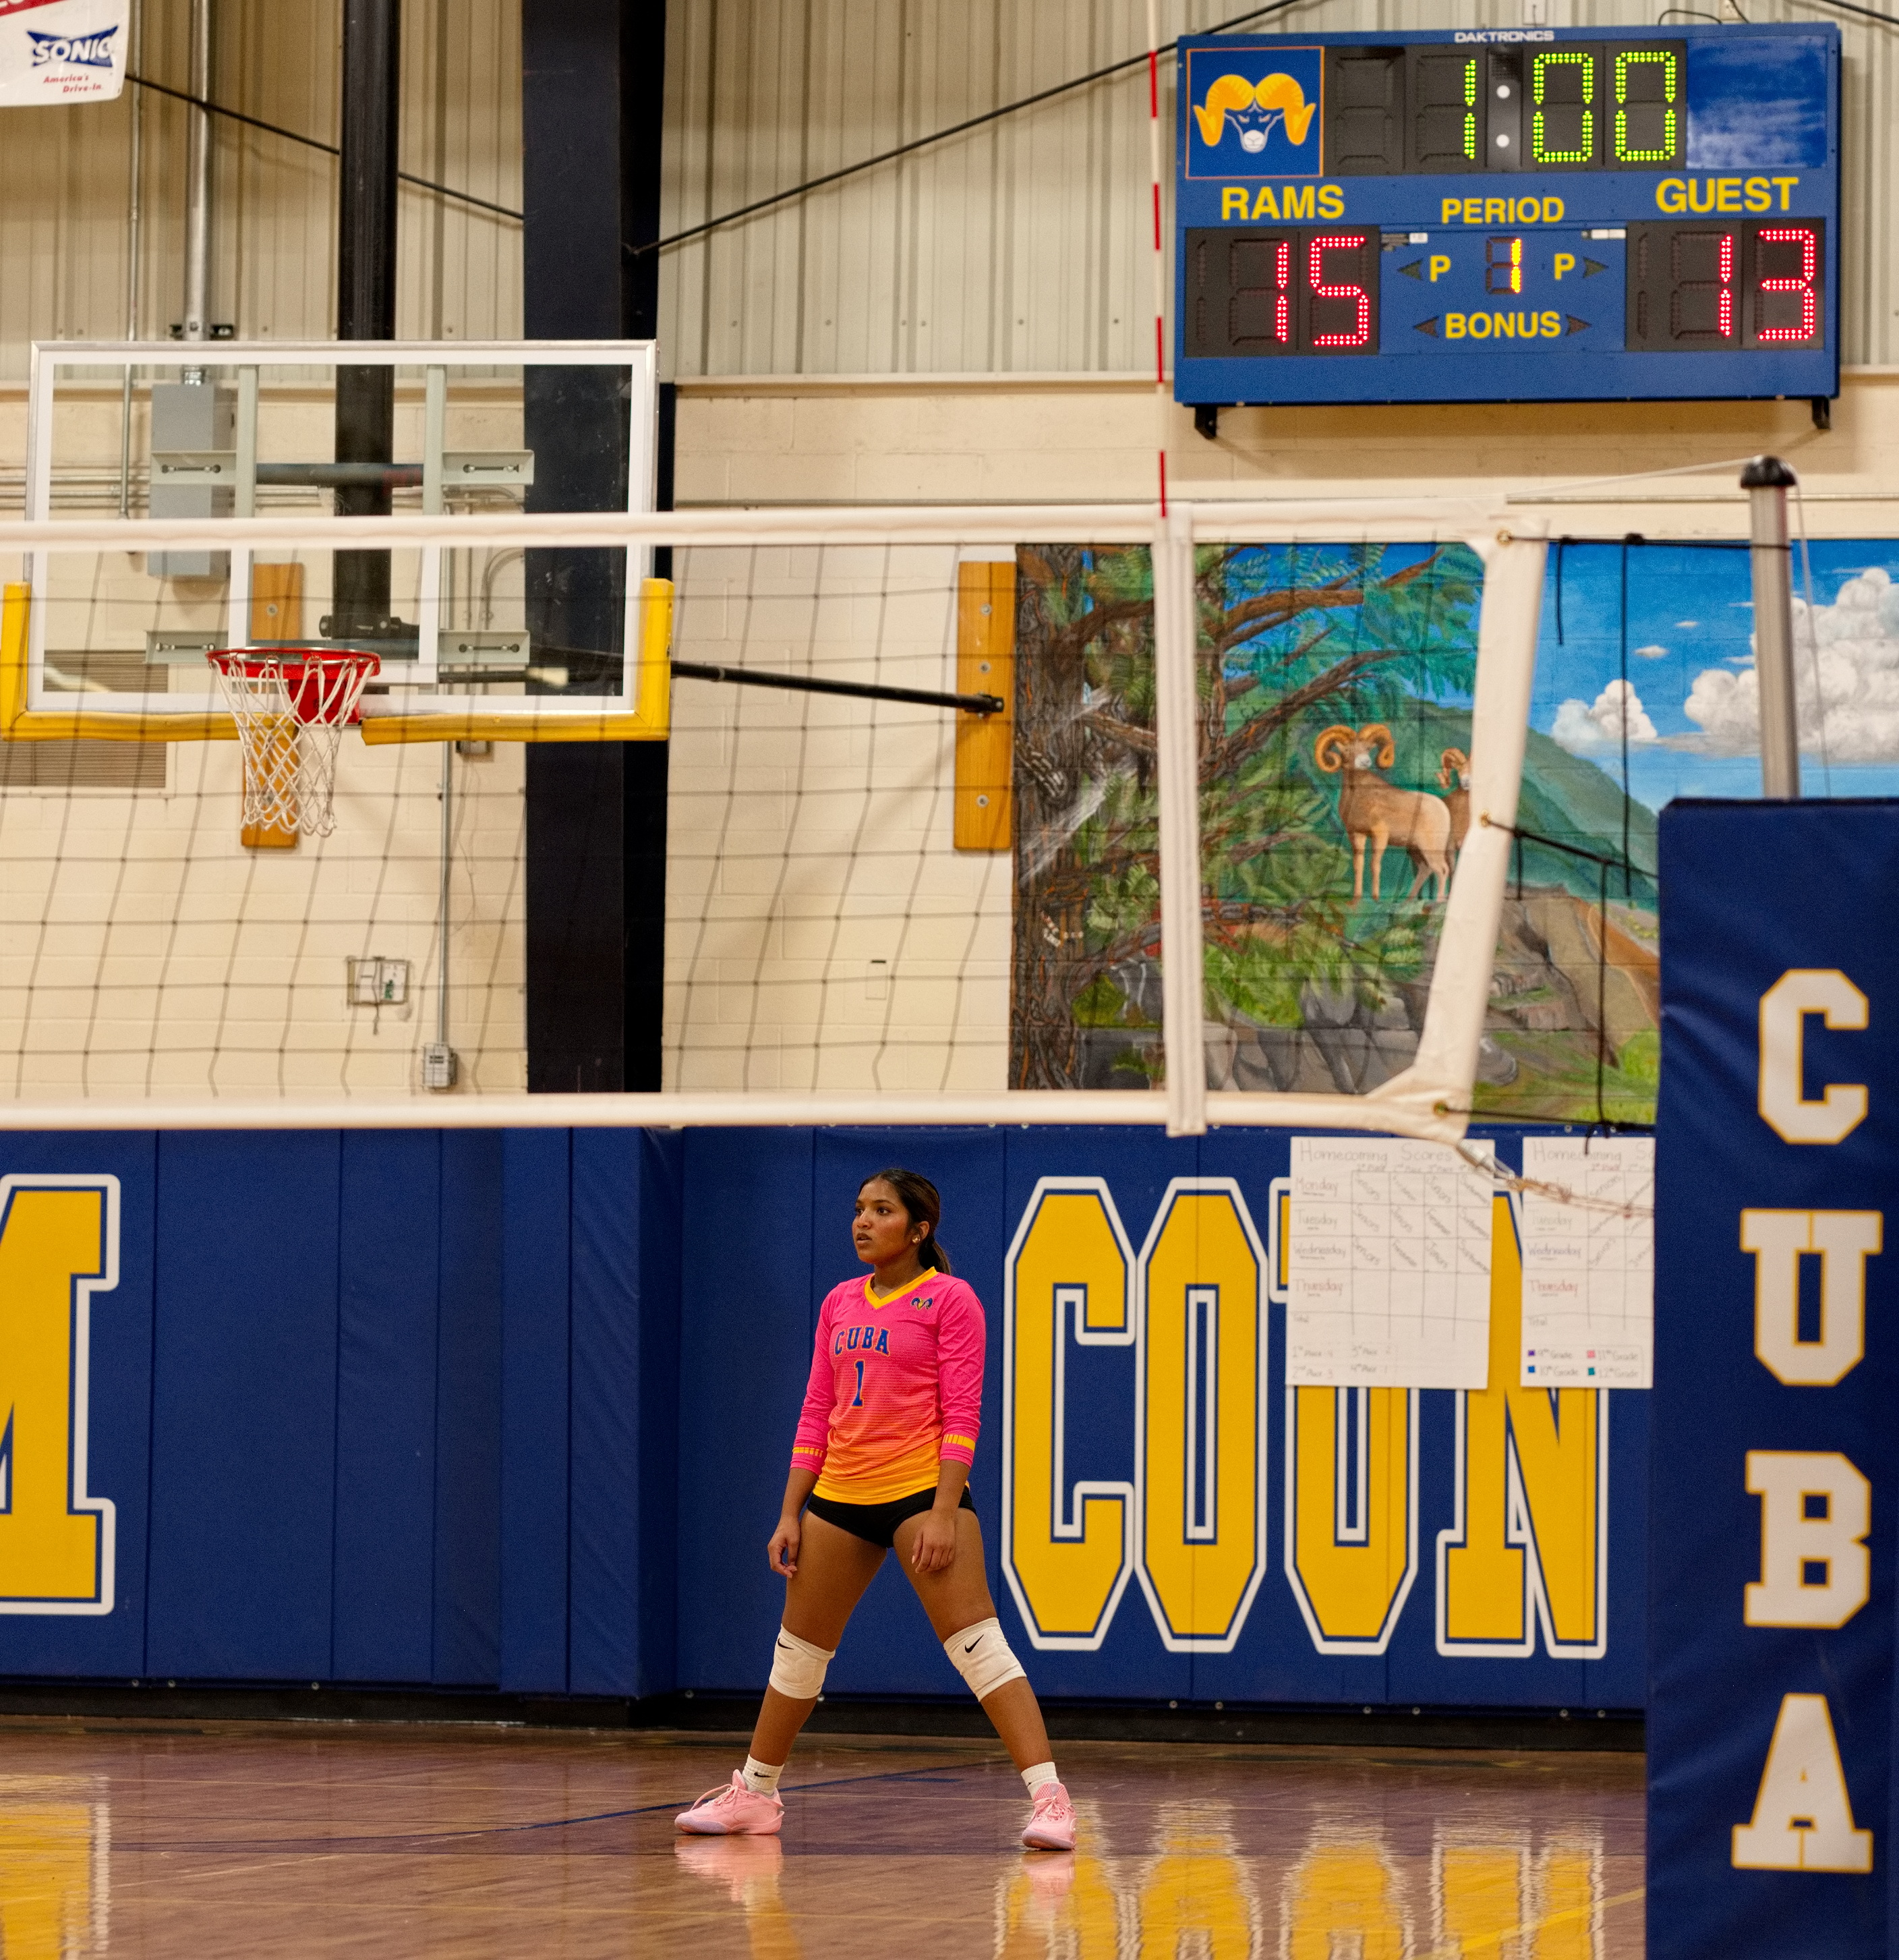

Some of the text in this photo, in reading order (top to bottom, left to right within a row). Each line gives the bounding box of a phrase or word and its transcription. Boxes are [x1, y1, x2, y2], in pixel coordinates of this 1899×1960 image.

[34, 36, 114, 63] SONIC
[1455, 30, 1554, 44] DAKTRONICS
[43, 73, 90, 84] America's
[62, 82, 103, 94] Drive-In
[1221, 184, 1345, 221] RAMS
[1656, 177, 1799, 214] GUEST
[1442, 197, 1565, 225] PERIOD
[1429, 255, 1451, 282] P
[1509, 237, 1523, 293] 1
[1554, 253, 1575, 280] P
[1275, 236, 1369, 346] 15
[1719, 229, 1816, 341] 13
[1445, 311, 1562, 339] BONUS
[834, 1325, 890, 1357] CUBA
[851, 1359, 865, 1408] 1
[1731, 968, 1883, 1874] CUBA
